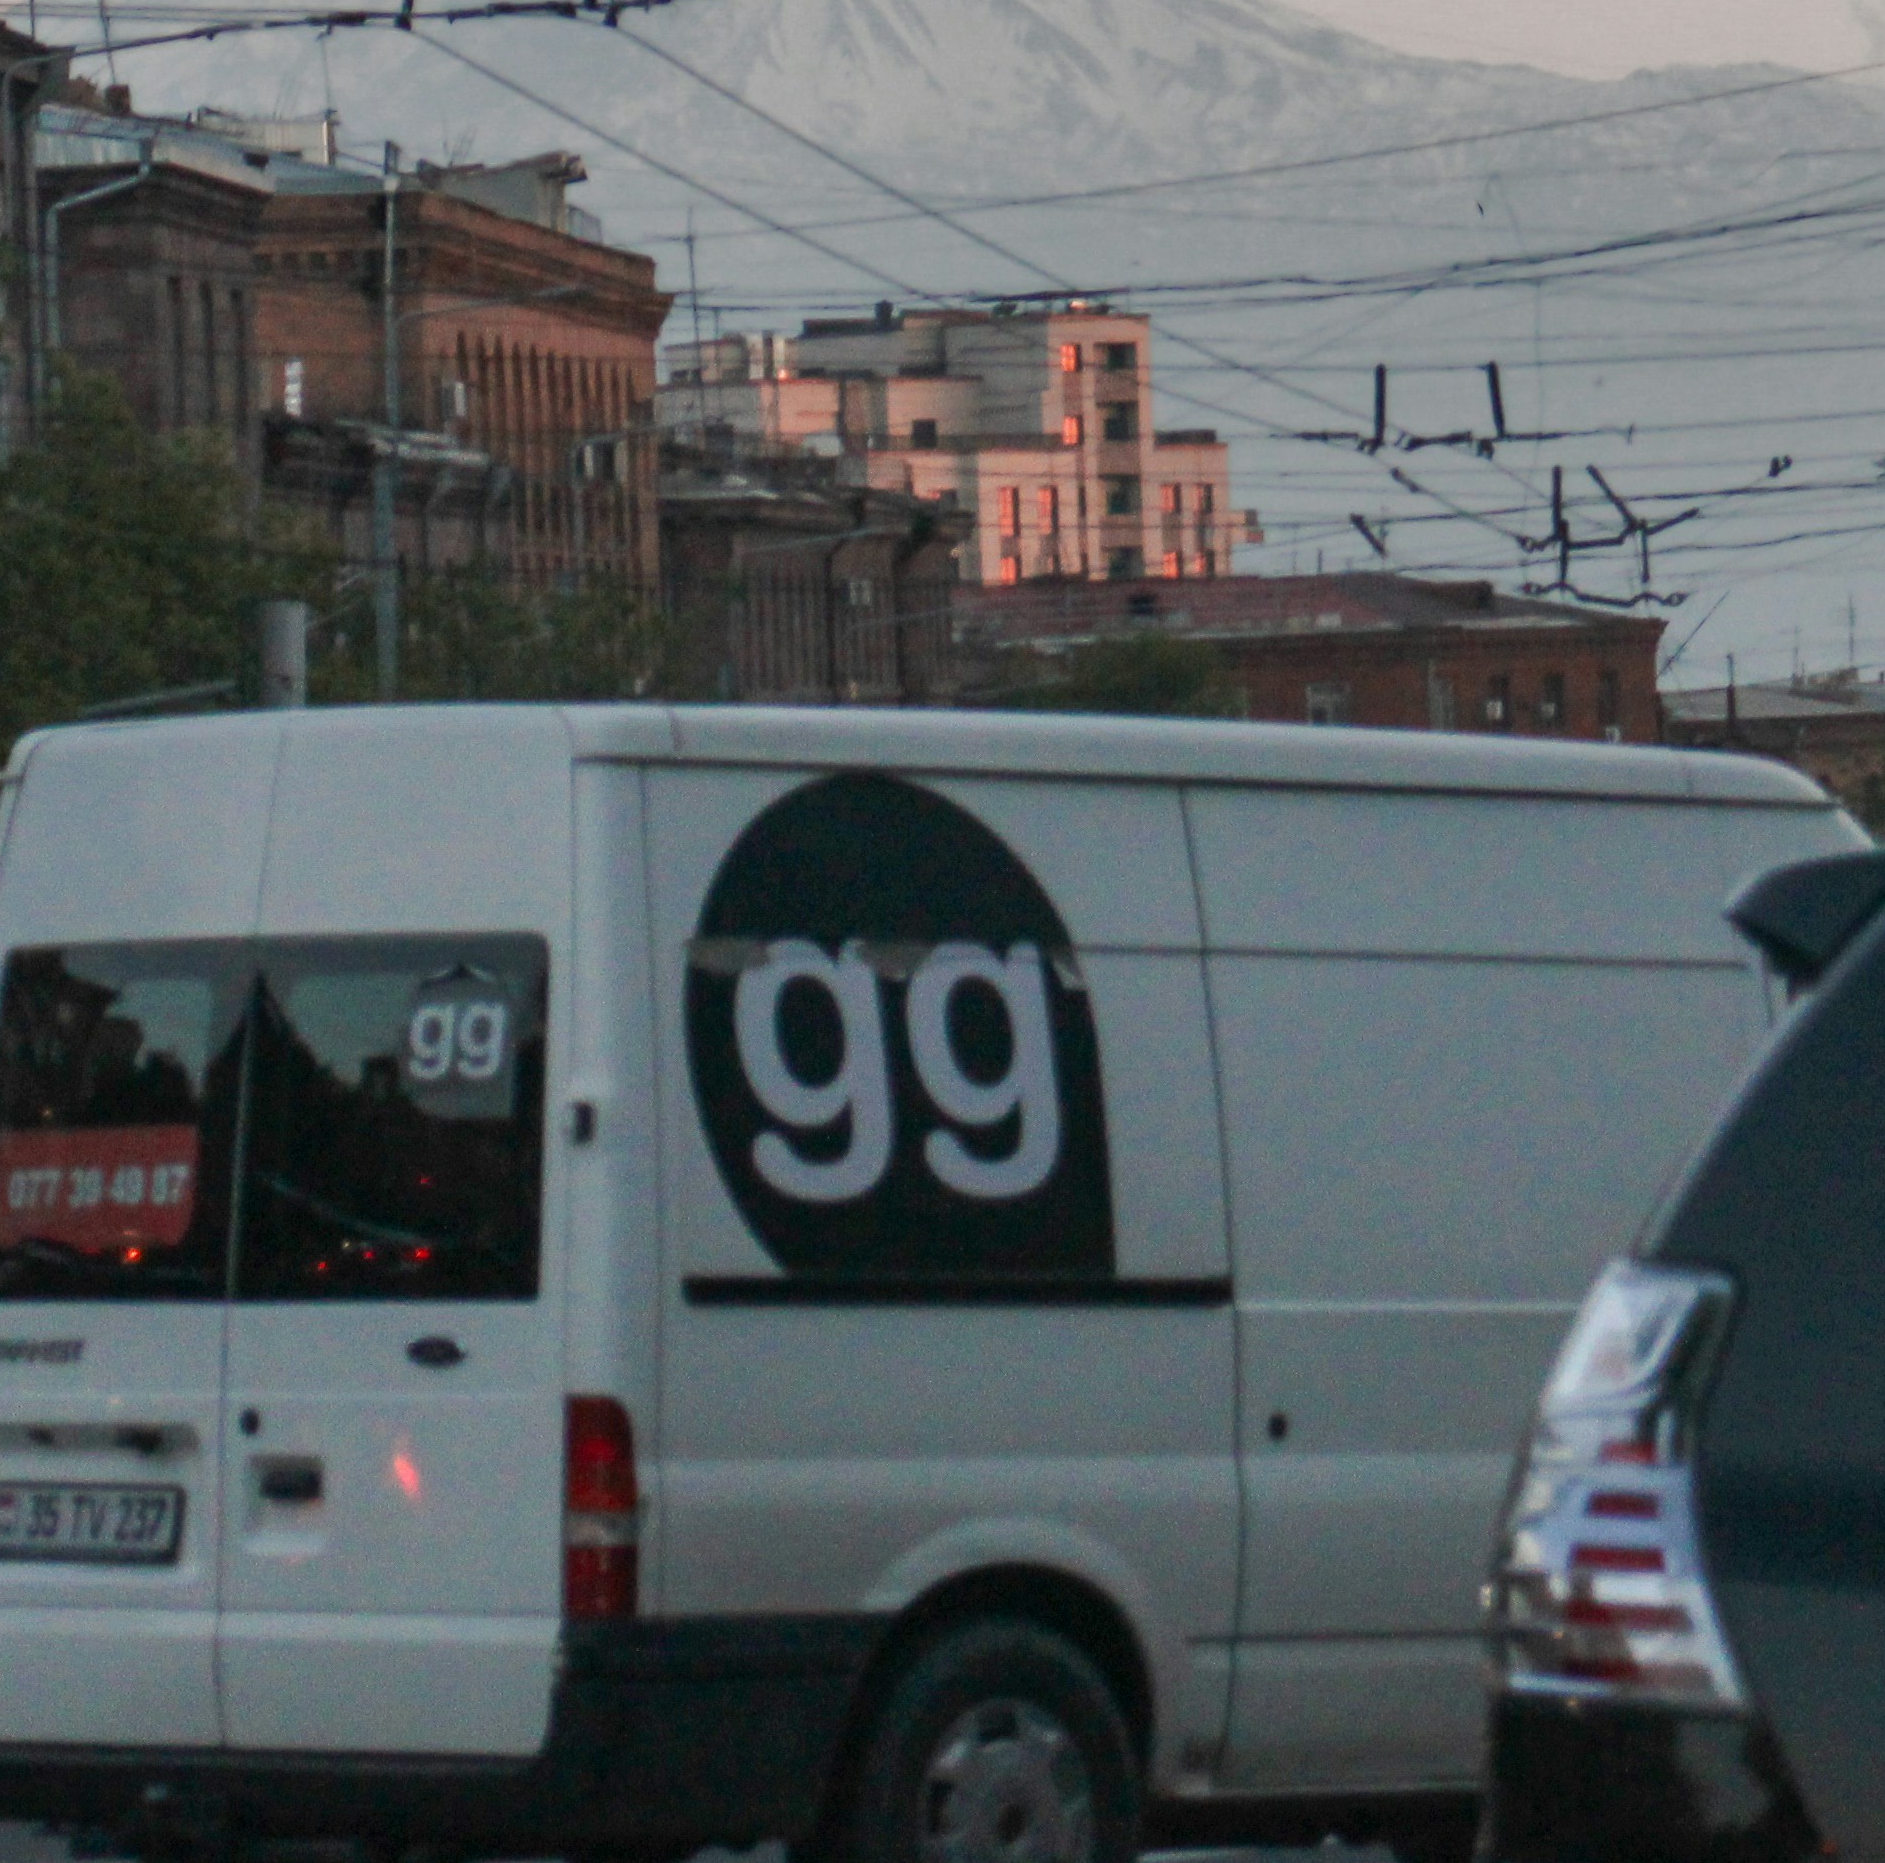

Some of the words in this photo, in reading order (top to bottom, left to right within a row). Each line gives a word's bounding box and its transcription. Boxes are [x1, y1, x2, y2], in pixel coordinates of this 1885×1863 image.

[409, 1005, 505, 1078] gg
[733, 938, 1063, 1203] gg
[8, 1169, 61, 1208] 077
[26, 1494, 60, 1538] 35
[72, 1495, 108, 1540] TV
[115, 1496, 168, 1541] 237
